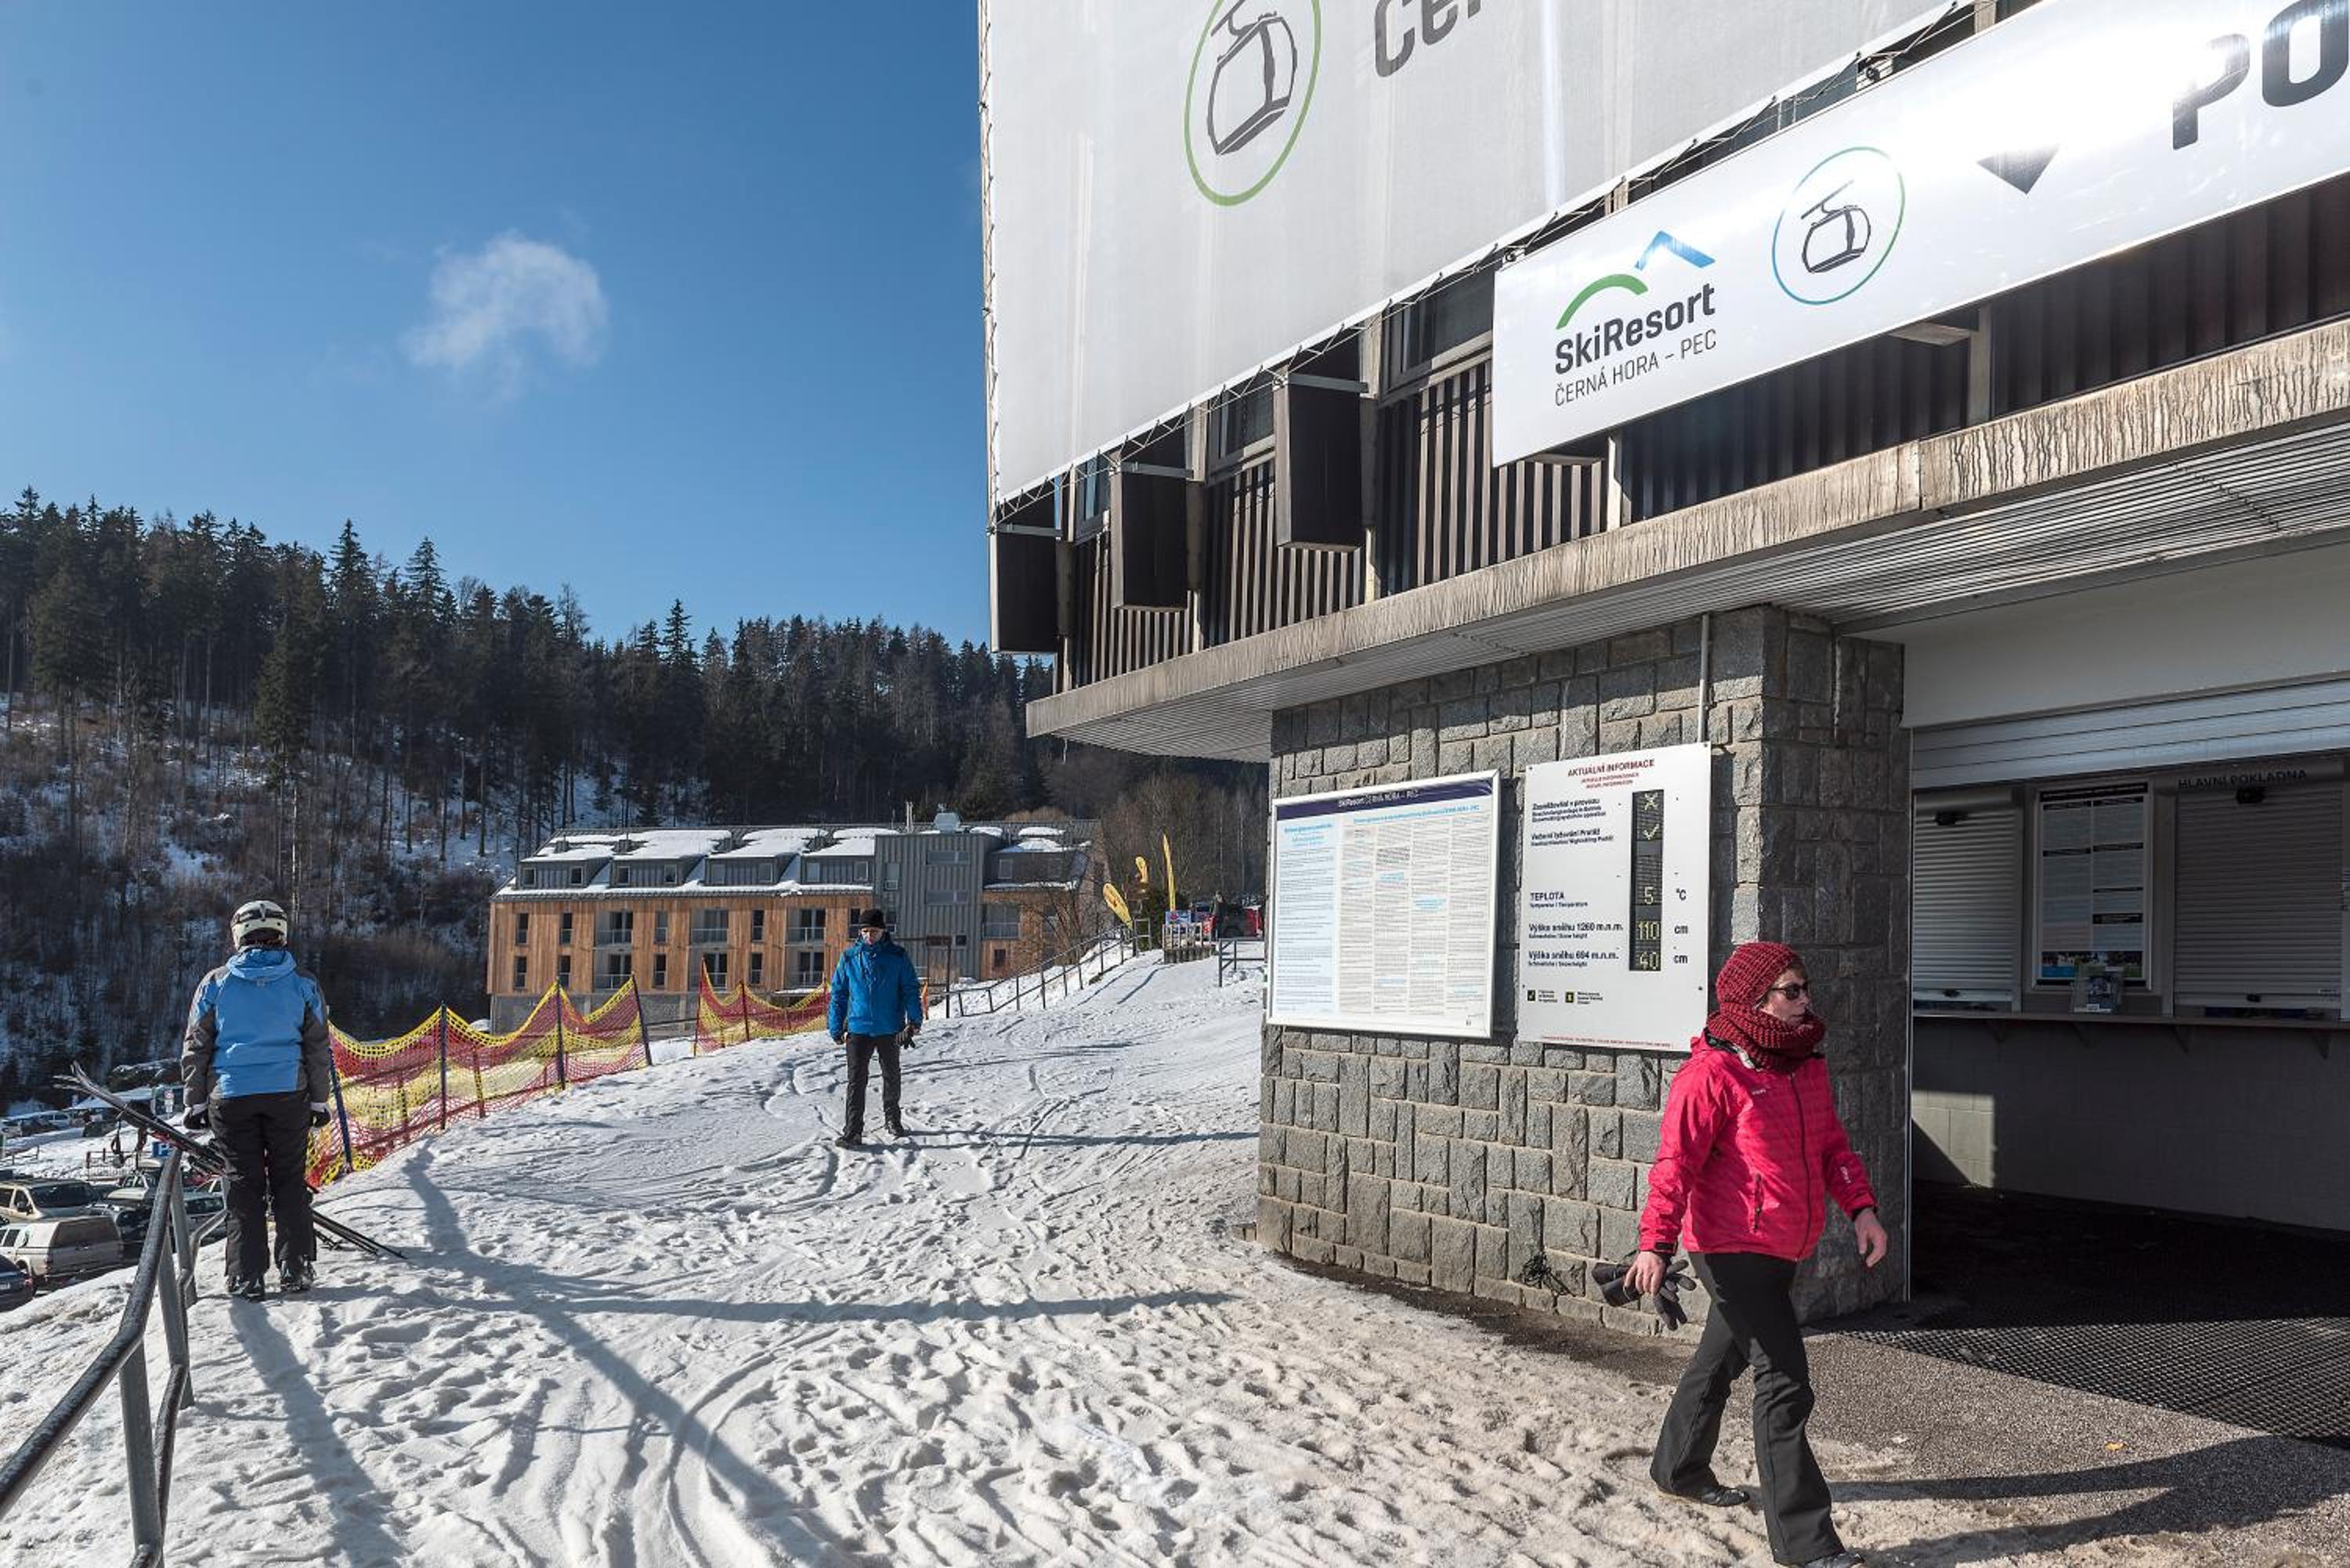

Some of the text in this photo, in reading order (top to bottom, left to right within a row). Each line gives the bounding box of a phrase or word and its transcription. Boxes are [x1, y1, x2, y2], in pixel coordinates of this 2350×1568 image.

[1555, 283, 1716, 374] SkiResort
[1555, 366, 1607, 406] ČERNÁ
[1613, 350, 1659, 386] HORA
[1680, 328, 1716, 359] PEC
[1606, 759, 1655, 773] INFORMACE
[1530, 892, 1564, 901] TEPLOTA
[1643, 886, 1654, 905] 5
[1638, 922, 1660, 940] 110
[1674, 925, 1688, 934] cm
[1640, 952, 1659, 970] 40
[1673, 955, 1688, 964] cm
